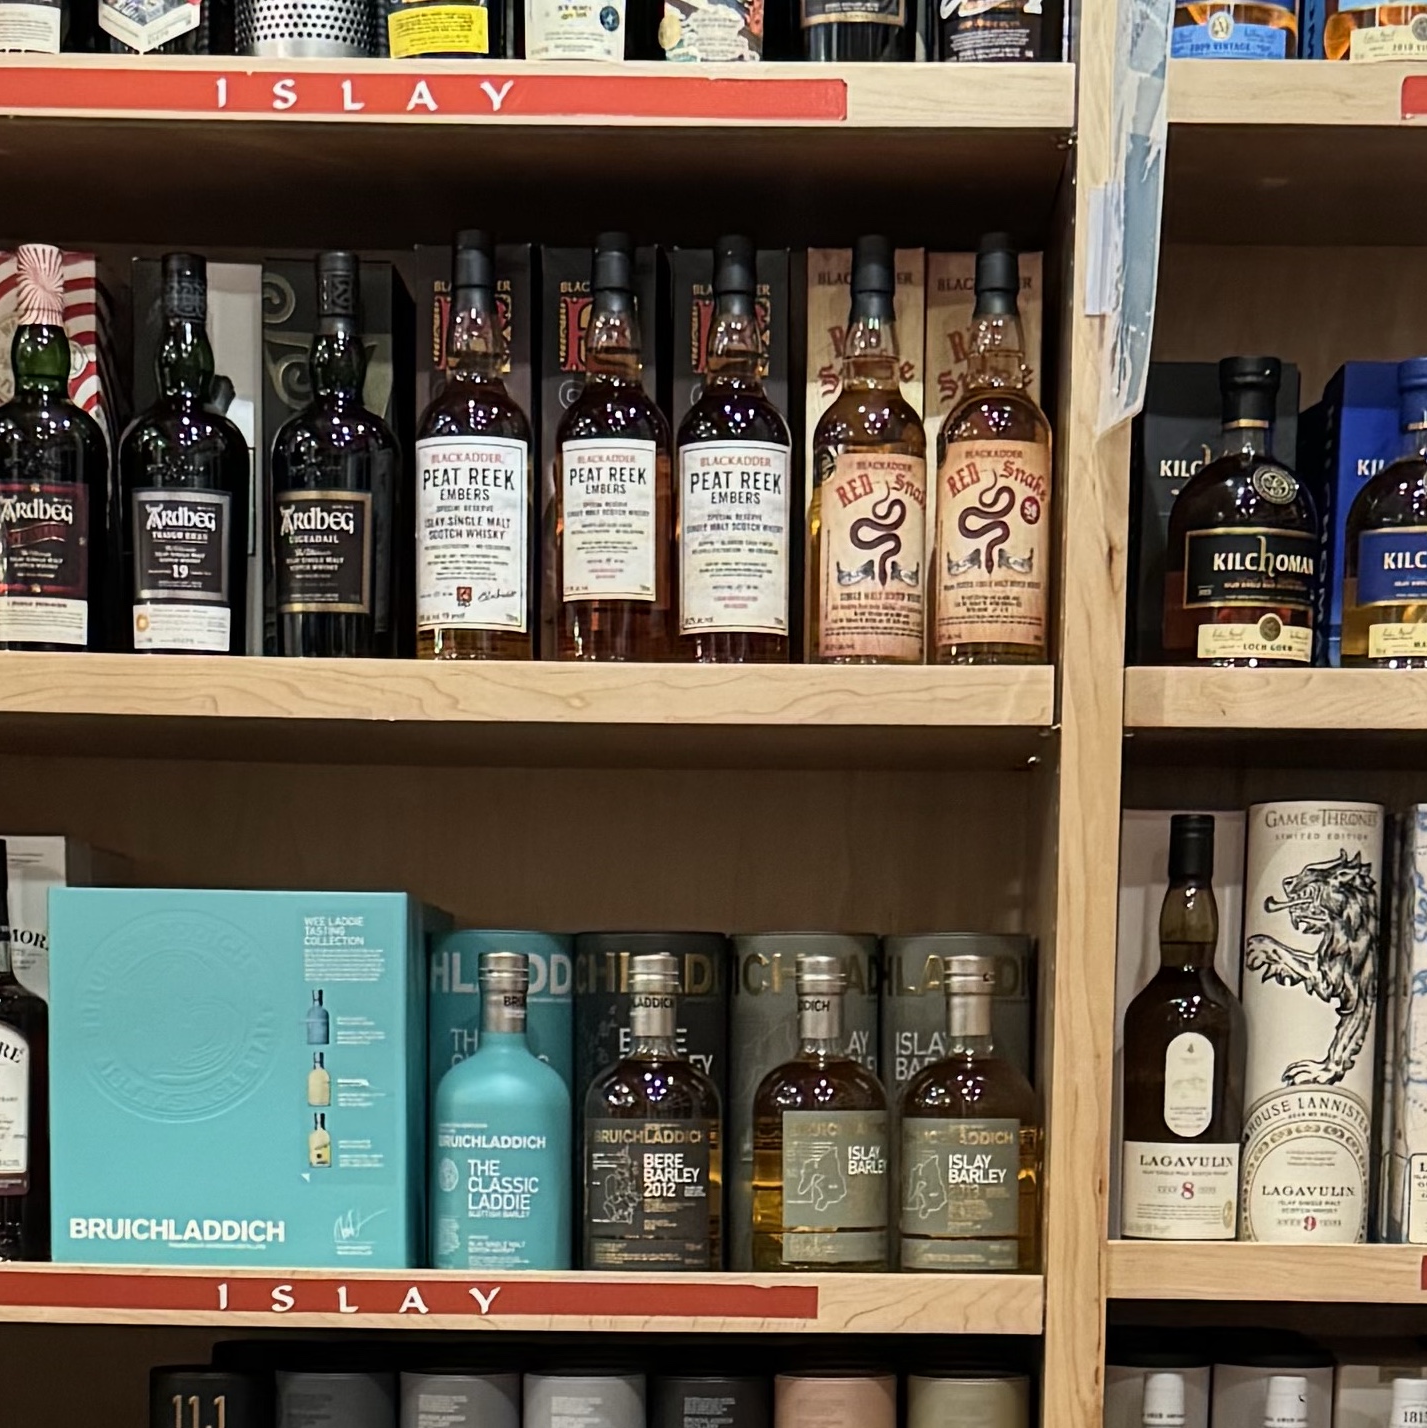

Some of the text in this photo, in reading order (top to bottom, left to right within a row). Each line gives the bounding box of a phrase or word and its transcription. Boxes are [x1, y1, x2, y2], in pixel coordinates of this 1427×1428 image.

[215, 77, 514, 112] ISLAY
[423, 467, 516, 492] PEAT REEK
[570, 466, 647, 486] PEAT REEK
[690, 472, 782, 495] PEAT REEK
[944, 462, 981, 499] RED
[440, 488, 490, 501] EMBERS
[585, 484, 626, 495] EMBERS
[837, 474, 875, 509] RED
[710, 491, 761, 505] EMBERS
[146, 503, 217, 532] Ardbeg
[279, 504, 355, 535] Ardbeg
[172, 563, 189, 579] 19
[1265, 811, 1308, 827] GAME
[304, 916, 326, 927] WEE
[304, 936, 365, 946] COLLECTION
[438, 1134, 546, 1149] BRUICHLADDICH
[643, 1153, 684, 1169] BERE
[848, 1145, 881, 1162] ISLAY
[948, 1154, 992, 1169] ISLAY
[1139, 1154, 1234, 1168] LAGAVULIN
[468, 1159, 501, 1176] THE
[643, 1168, 701, 1183] BARLEY
[948, 1169, 1007, 1184] BARLEY
[468, 1176, 539, 1194] CLASSIC
[643, 1183, 676, 1197] 2012
[1180, 1181, 1195, 1199] 8
[1262, 1185, 1355, 1198] LAGAVULIN
[468, 1194, 531, 1210] LADDIE
[70, 1218, 285, 1242] BRUICHLADDICH
[1303, 1215, 1317, 1232] 9
[216, 1281, 501, 1316] ISLAY
